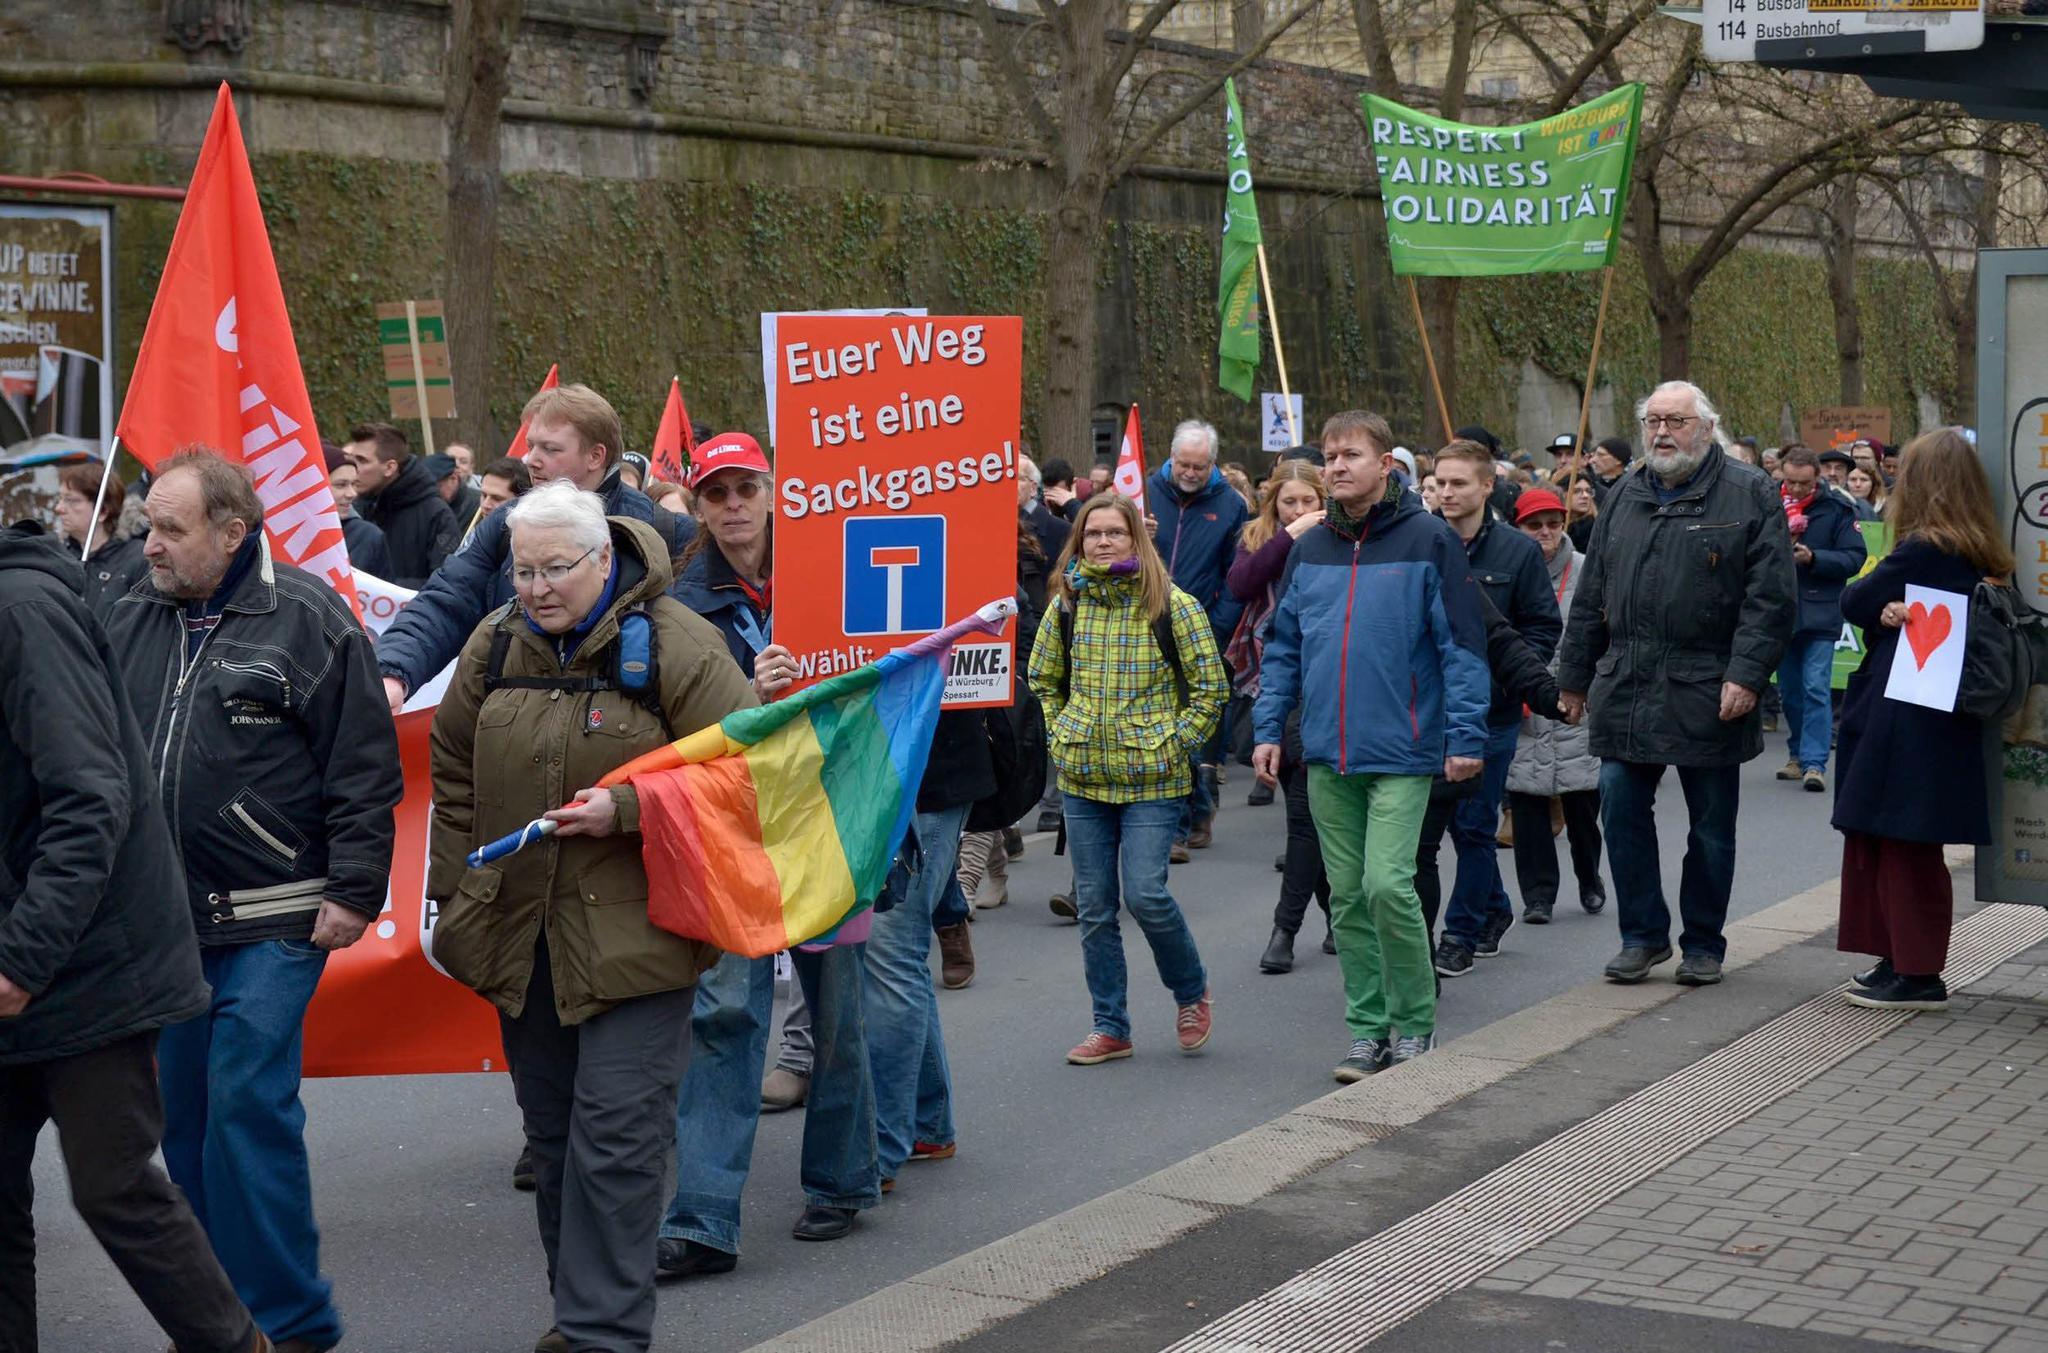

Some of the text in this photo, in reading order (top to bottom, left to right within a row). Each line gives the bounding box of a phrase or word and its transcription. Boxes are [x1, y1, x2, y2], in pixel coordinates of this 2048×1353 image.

[1718, 19, 1840, 40] 114 Busbahnhof
[1558, 133, 1584, 156] IST
[1375, 155, 1551, 188] FAIRNESS
[785, 322, 987, 385] Euer Weg
[809, 392, 964, 448] ist eine
[781, 441, 1016, 519] Sackgasse!
[792, 645, 873, 679] Wählt:
[943, 690, 979, 701] Spessart
[955, 677, 994, 687] Würzburg
[230, 715, 254, 725] JOHN
